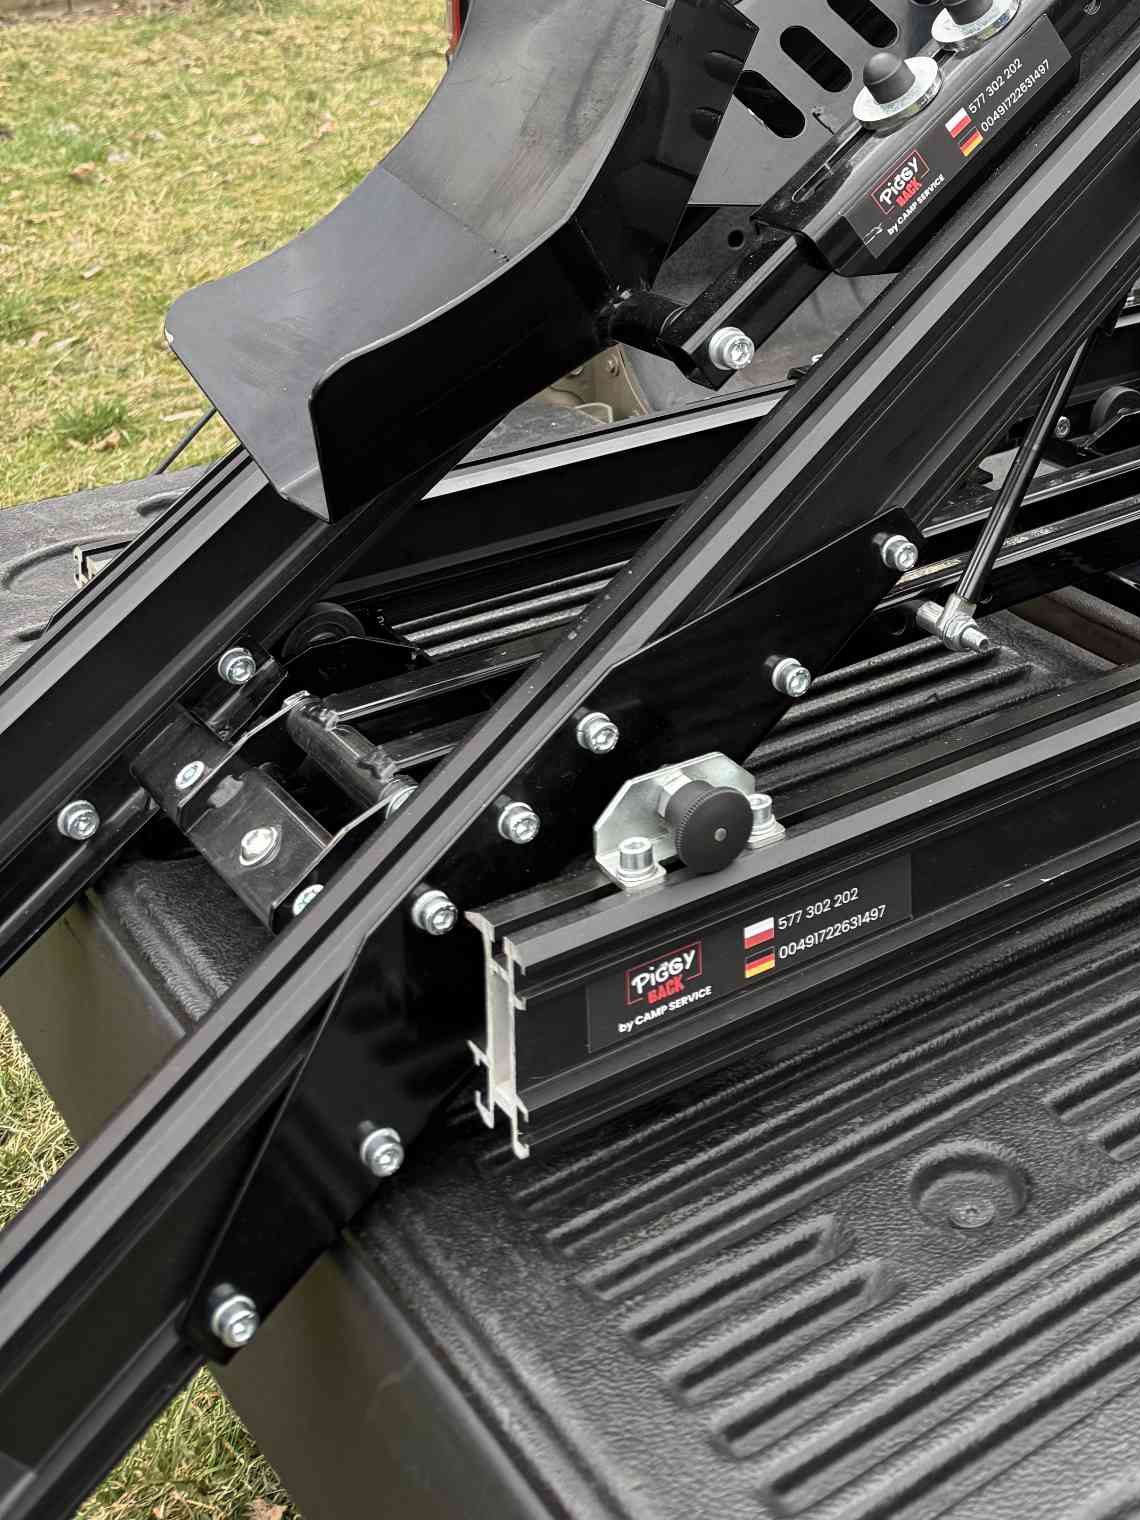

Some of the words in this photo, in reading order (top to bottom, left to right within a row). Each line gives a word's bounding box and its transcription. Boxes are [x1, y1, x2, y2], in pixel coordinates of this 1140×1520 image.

[968, 92, 986, 113] 577
[985, 75, 1005, 97] 302
[1003, 58, 1023, 80] 202
[981, 58, 1050, 132] 00491722631497
[887, 223, 899, 236] by
[897, 202, 918, 225] CAMP
[916, 173, 945, 205] SERVICE
[778, 910, 803, 930] 577
[805, 898, 832, 919] 302
[833, 887, 860, 908] 202
[779, 904, 887, 959] 00491722631497
[617, 1021, 634, 1033] by
[634, 1005, 668, 1025] CAMP
[667, 985, 712, 1011] SERVICE
[647, 974, 685, 1005] BACK
